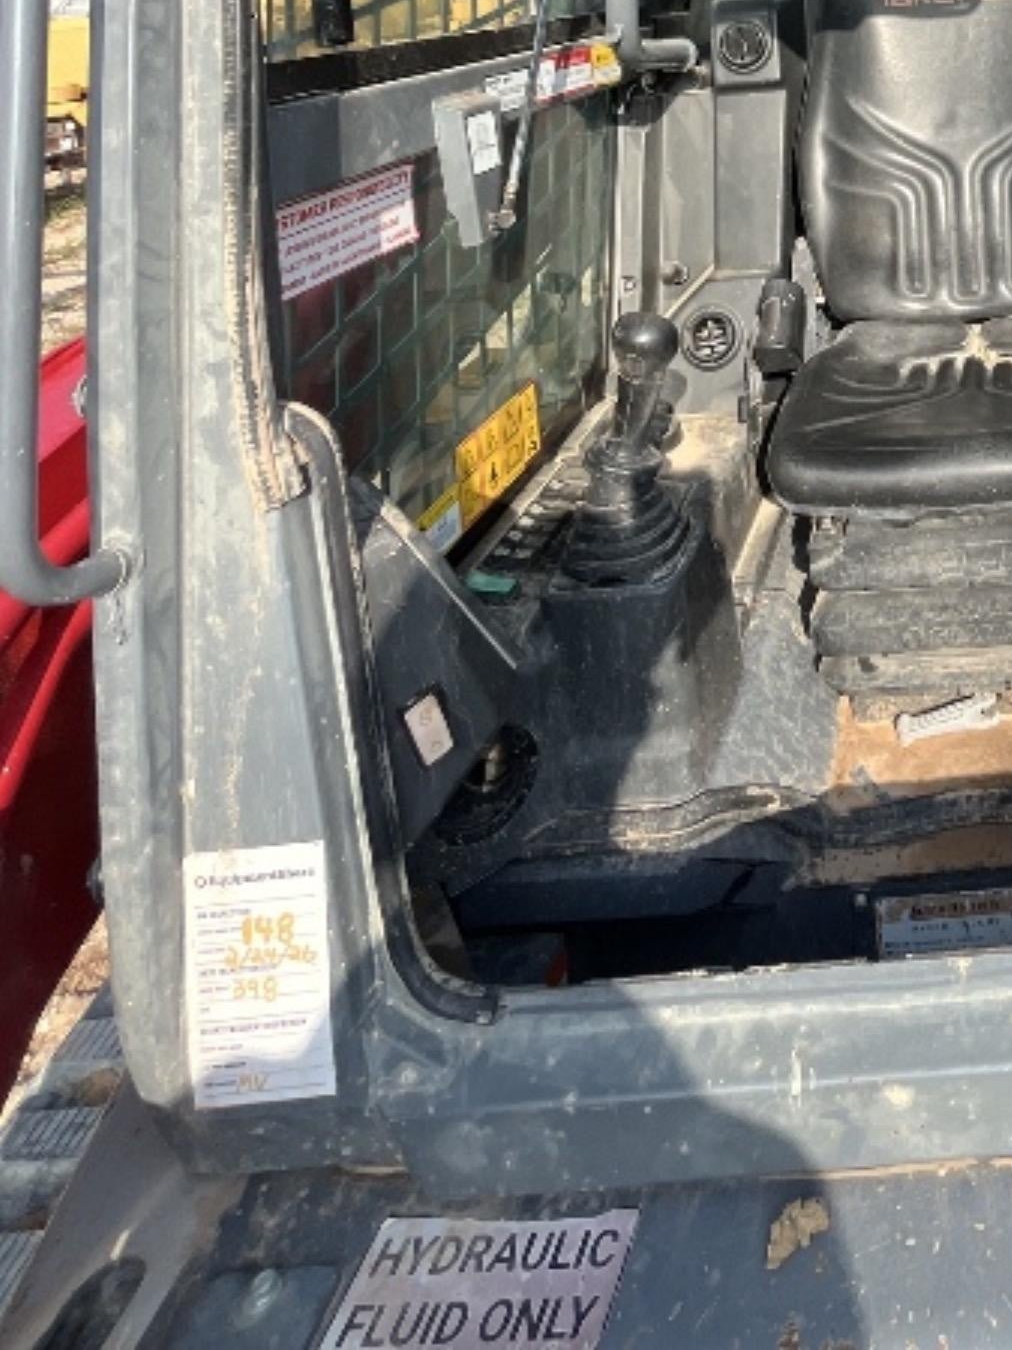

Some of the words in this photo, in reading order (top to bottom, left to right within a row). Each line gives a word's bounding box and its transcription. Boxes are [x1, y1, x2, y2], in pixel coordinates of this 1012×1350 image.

[368, 1229, 619, 1278] HYDRAULIC
[335, 1299, 469, 1349] FLUID
[479, 1295, 599, 1343] ONLY
